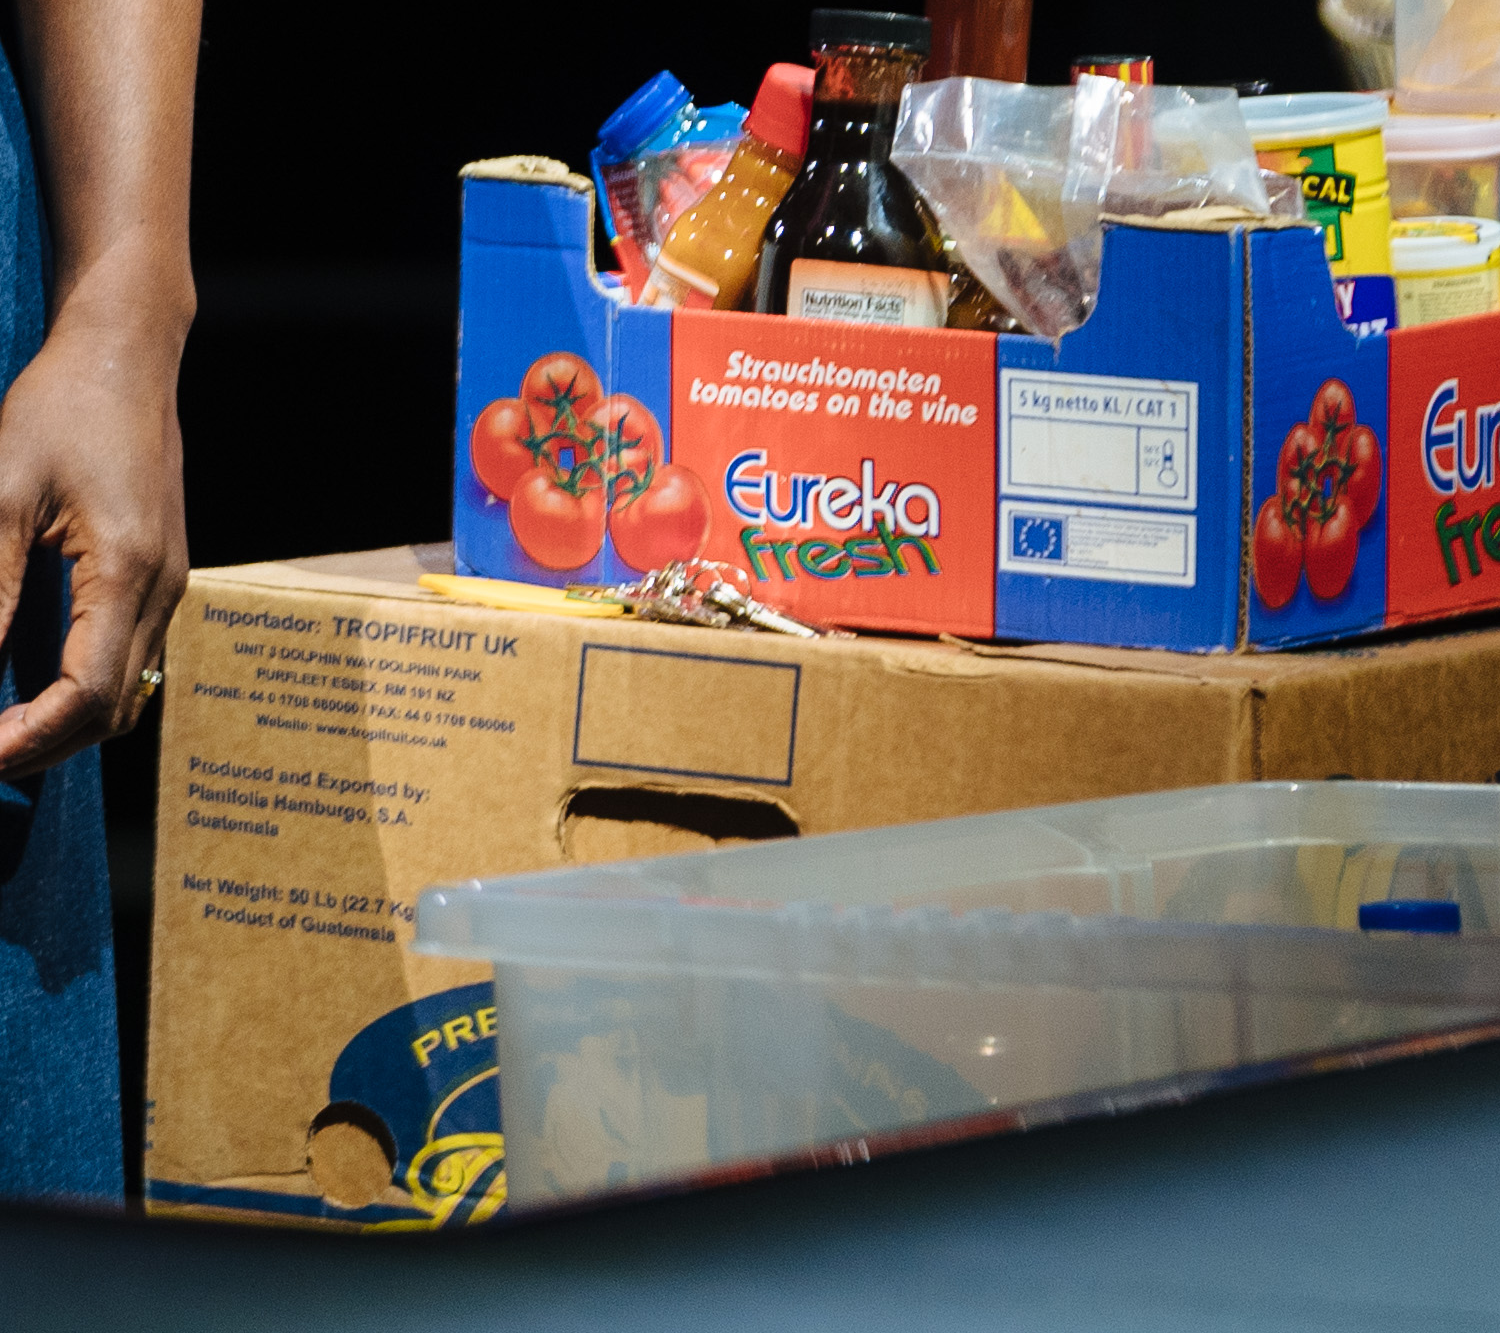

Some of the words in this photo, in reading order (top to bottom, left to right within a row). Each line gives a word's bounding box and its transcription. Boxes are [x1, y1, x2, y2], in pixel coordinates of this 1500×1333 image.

[805, 291, 862, 310] Nutrition
[866, 297, 900, 313] Facts
[725, 350, 941, 395] Strauchtomaten
[689, 378, 820, 413] tomatoes
[826, 395, 861, 416] on
[868, 391, 913, 420] the
[921, 396, 978, 425] vine
[1019, 389, 1027, 406] 5
[1032, 391, 1050, 413] kg
[1055, 394, 1098, 412] netto
[1103, 396, 1121, 413] KL
[1125, 398, 1133, 415] /
[1136, 398, 1163, 417] CAT
[1168, 401, 1177, 418] 1
[724, 448, 941, 537] Eureka
[740, 521, 941, 582] fresh
[204, 603, 321, 634] Importador:
[333, 616, 477, 652] TROPIFRUIT
[484, 635, 519, 657] UK
[234, 642, 265, 656] UNIT
[280, 647, 341, 665] DOLPHIN
[345, 654, 376, 668] WAY
[379, 659, 440, 677] DOLPHIN
[444, 668, 482, 681] PARK
[194, 683, 245, 701] PHONE:
[249, 690, 264, 702] 44
[268, 693, 275, 703] 0
[280, 694, 309, 708] 1708
[370, 704, 401, 719] FAX:
[405, 709, 420, 721] 44
[424, 711, 431, 722] 0
[435, 712, 466, 726] 1708
[256, 667, 329, 687] PURFLEET
[385, 683, 406, 695] RM
[437, 690, 456, 703] NZ
[256, 714, 311, 731] Website:
[316, 723, 447, 748] www.tropifruit.co.uk
[190, 756, 273, 781] Produced
[279, 771, 311, 786] and
[318, 772, 398, 797] Exported
[403, 783, 430, 804] by:
[187, 810, 279, 837] Guatemala
[188, 783, 268, 809] Planifolia
[274, 795, 371, 824] Hamburgo,
[377, 807, 413, 826] S.A.
[183, 873, 212, 891] Net
[217, 878, 283, 903] Weight:
[289, 888, 309, 904] 50
[315, 891, 337, 908] Lb
[342, 894, 384, 914] (22.7
[204, 903, 273, 927] Product
[279, 913, 297, 929] of
[301, 917, 396, 943] Guatemala
